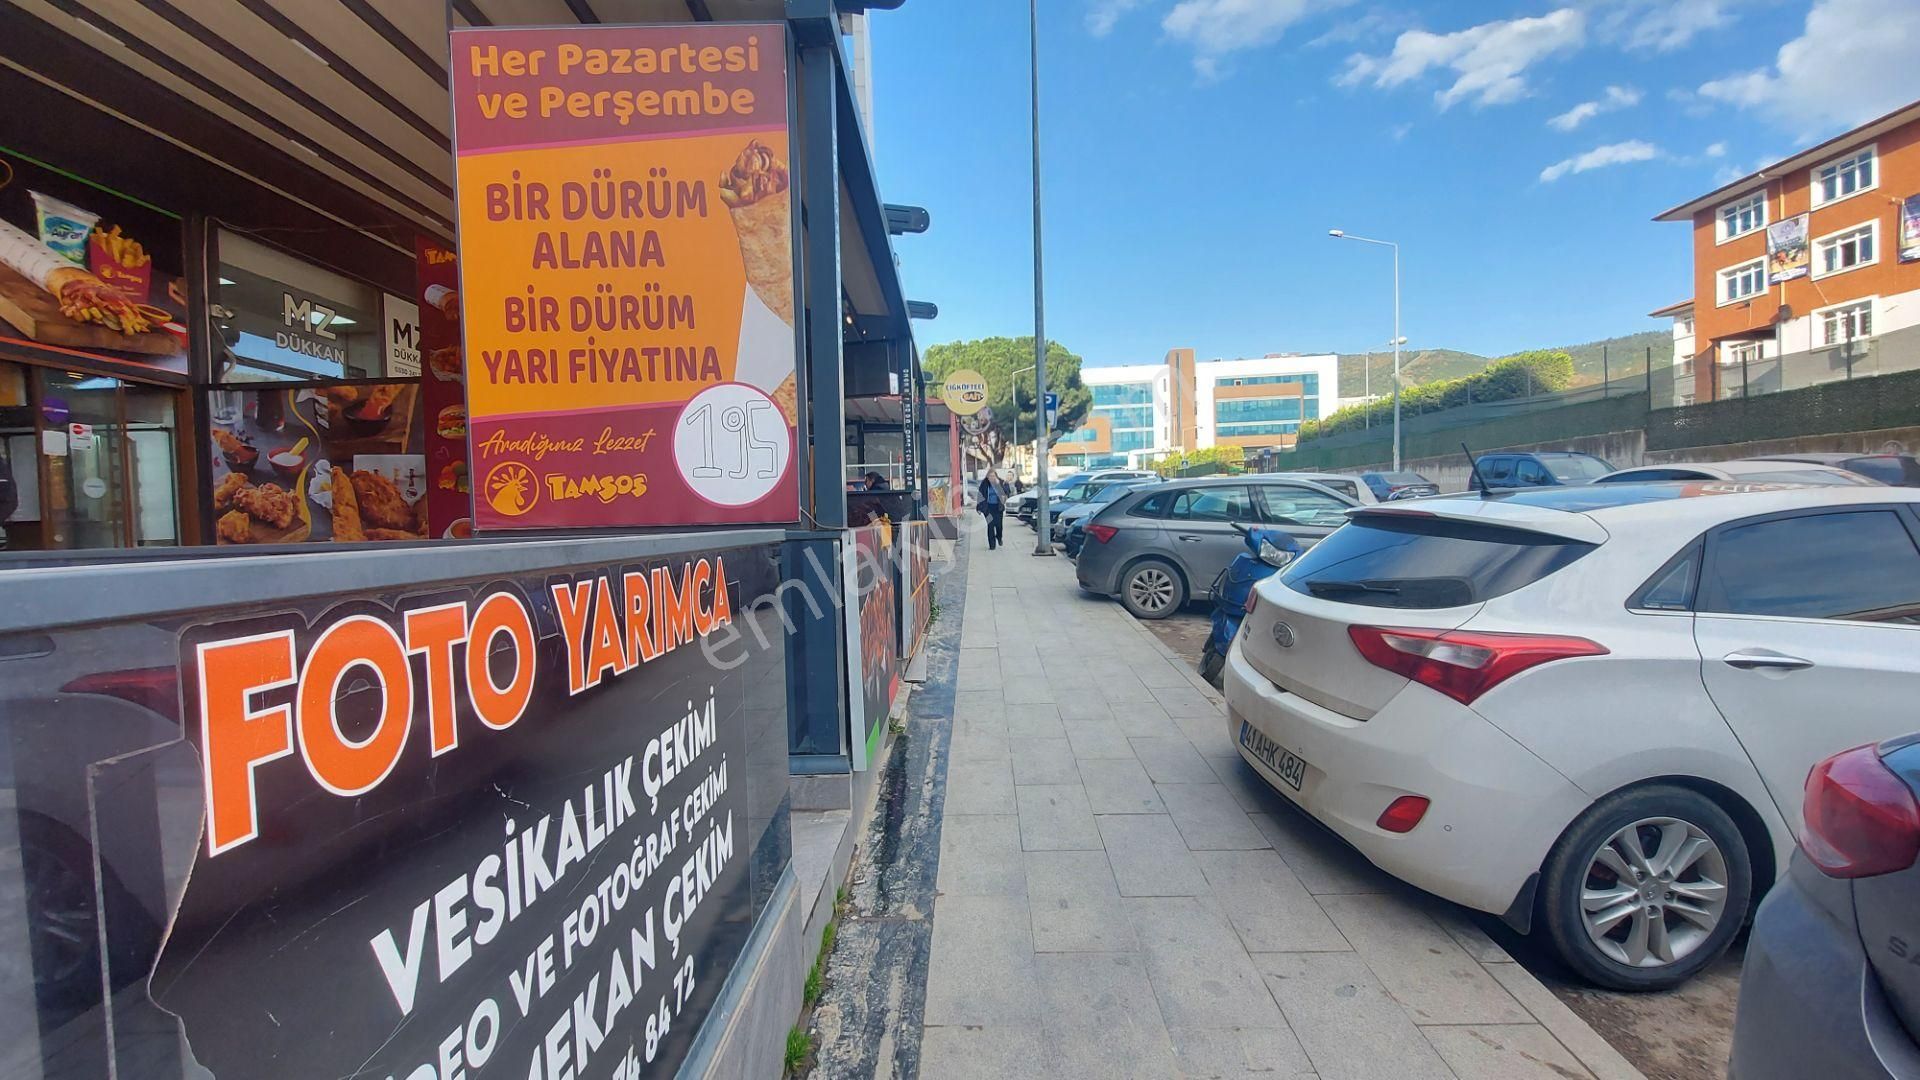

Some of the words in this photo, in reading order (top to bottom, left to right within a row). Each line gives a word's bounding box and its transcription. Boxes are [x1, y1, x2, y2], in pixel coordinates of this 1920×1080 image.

[470, 45, 546, 77] Her
[558, 36, 759, 76] Pazartesi
[477, 90, 528, 120] ve
[540, 81, 755, 126] Perşembe
[485, 169, 551, 222] BİR
[562, 167, 708, 221] DÜRÜM
[532, 230, 665, 270] ALANA
[282, 291, 337, 341] MZ
[505, 284, 561, 333] BİR
[570, 282, 696, 332] DÜRÜM
[275, 330, 345, 366] DÜKKAN
[481, 348, 559, 385] YARI
[569, 335, 723, 385] FİYATINA
[478, 429, 585, 461] Aradığınız
[592, 426, 657, 455] Lezzet
[686, 399, 779, 480] 195
[196, 591, 537, 858] FOTO
[551, 556, 732, 696] YARIMCA
[1279, 752, 1301, 785] 484
[370, 756, 636, 1017] VESİKALIK
[642, 685, 717, 815] ÇEKİMİ
[509, 934, 554, 1018] VE
[562, 807, 680, 970] FOTOĞRAF
[683, 752, 728, 844] ÇEKİMİ
[663, 808, 734, 959] ÇEKİM
[644, 995, 671, 1063] 84
[673, 955, 695, 1017] 72
